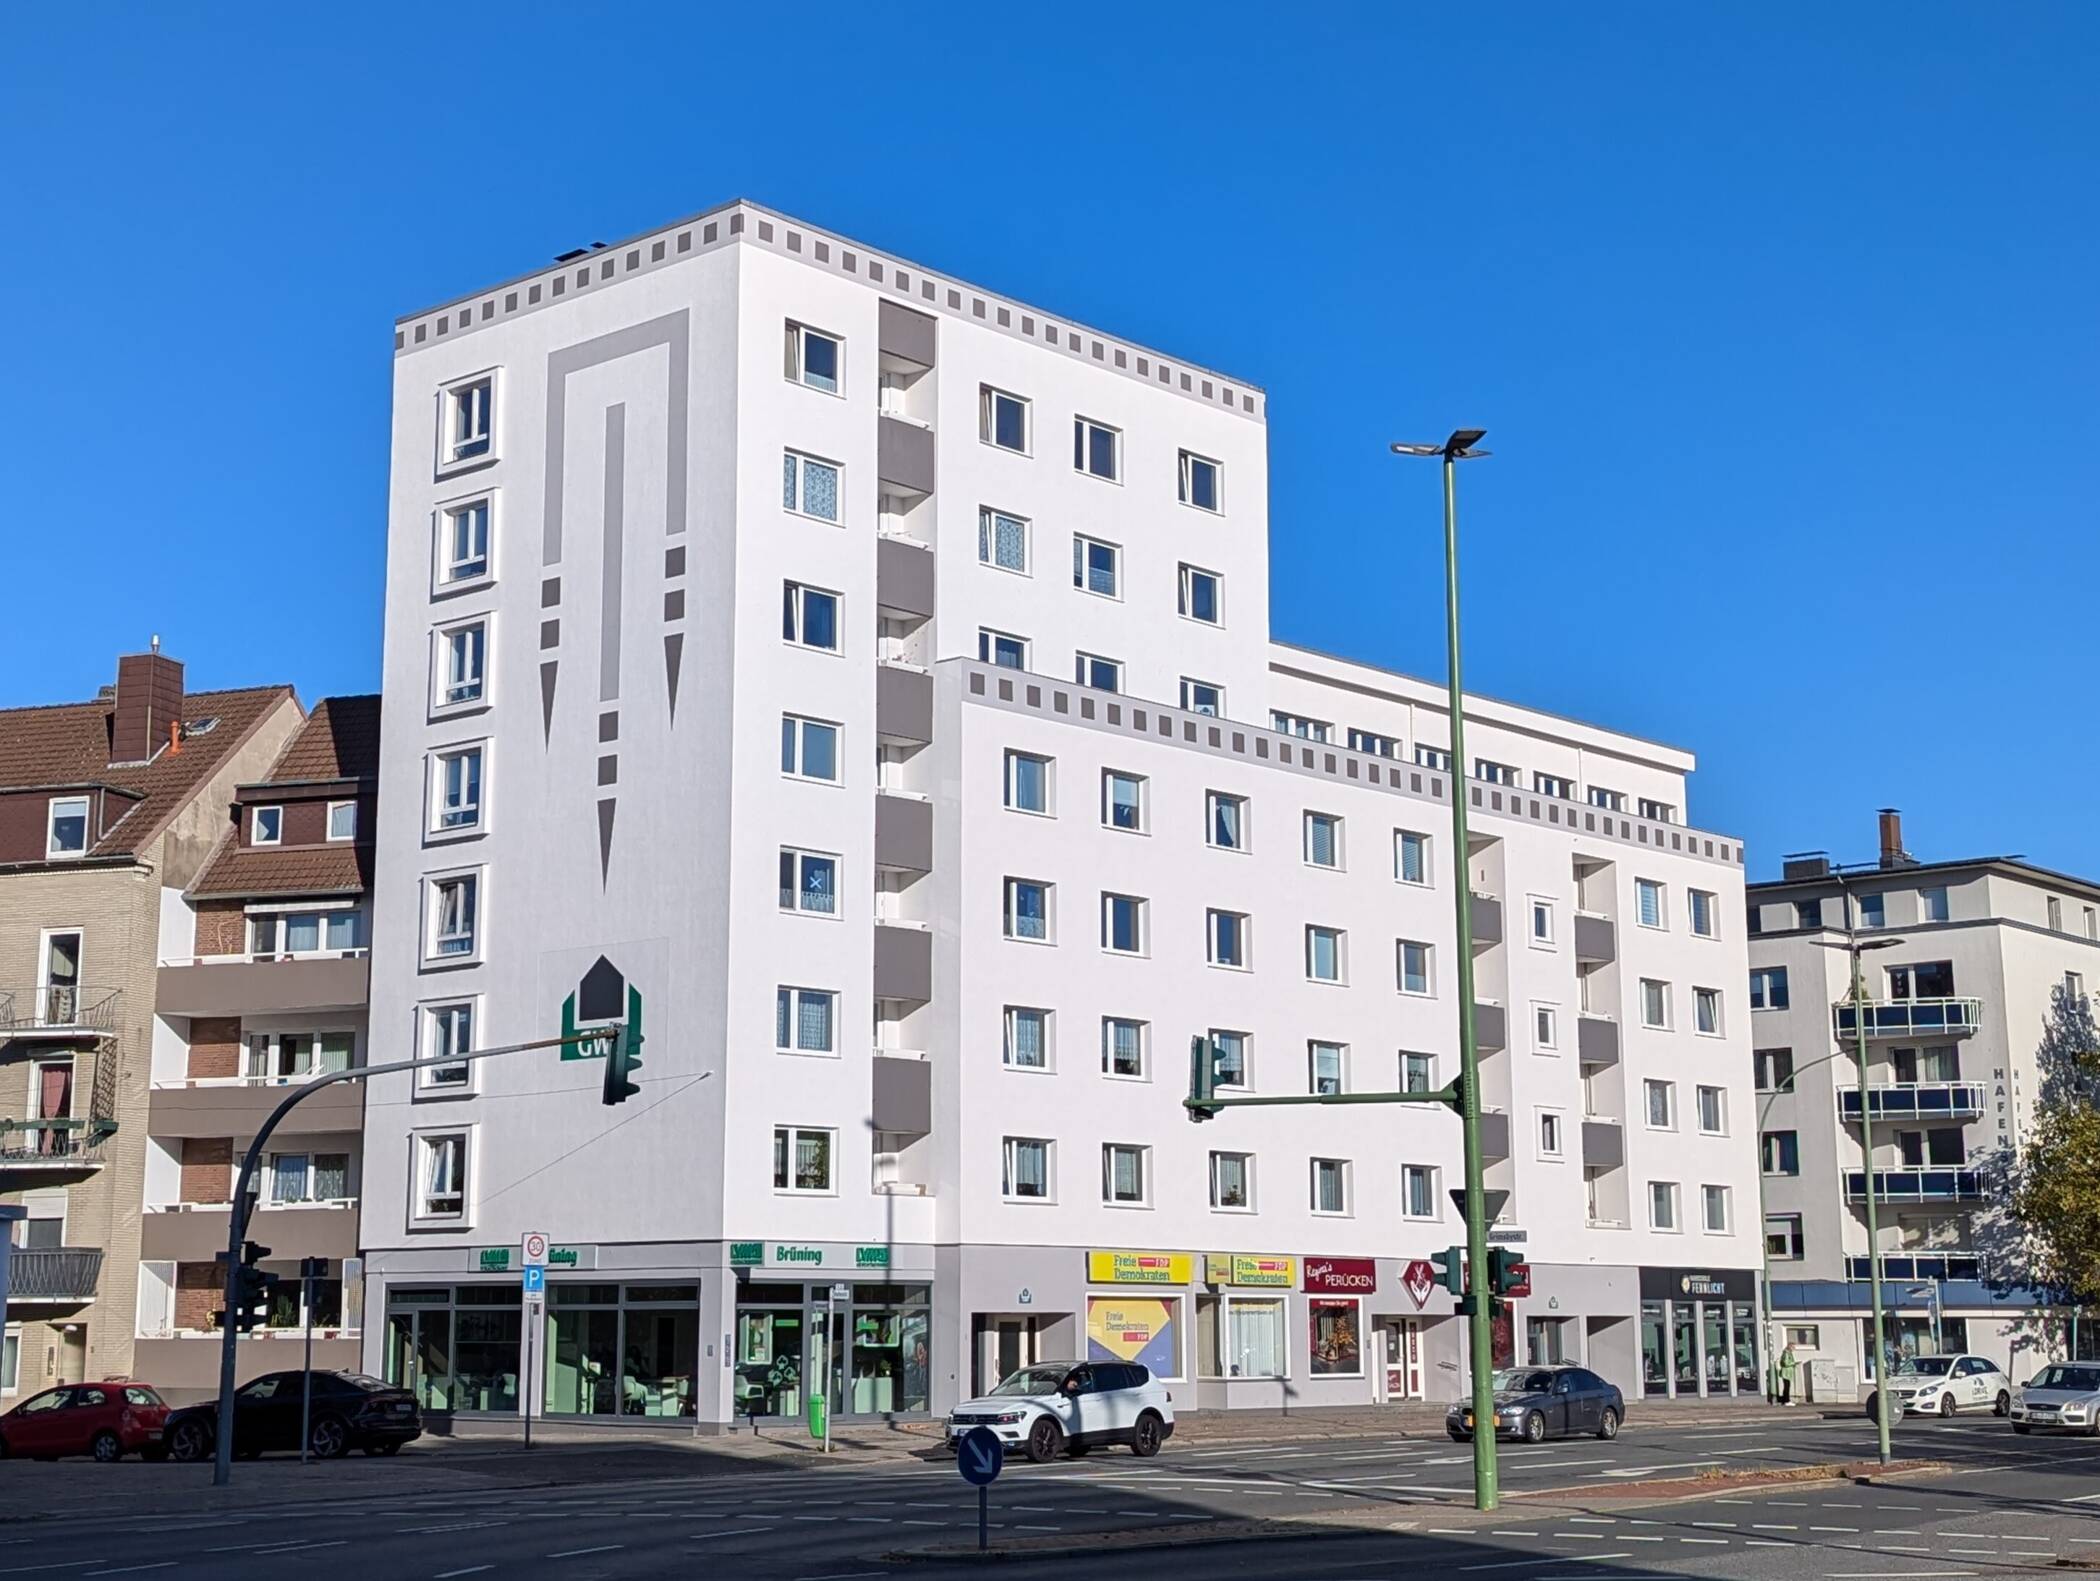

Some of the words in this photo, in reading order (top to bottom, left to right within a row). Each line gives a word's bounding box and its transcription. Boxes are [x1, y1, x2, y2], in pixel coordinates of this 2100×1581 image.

[577, 1029, 611, 1057] GW
[531, 1241, 541, 1252] 30
[549, 1248, 577, 1267] üning
[777, 1246, 822, 1265] Brüning
[1114, 1255, 1136, 1266] Freie
[1114, 1268, 1170, 1281] Demokraten
[1236, 1272, 1288, 1283] Demokraten
[1325, 1272, 1374, 1287] PERÜCKEN
[1105, 1311, 1124, 1321] Freie
[1105, 1321, 1149, 1331] Demokraten
